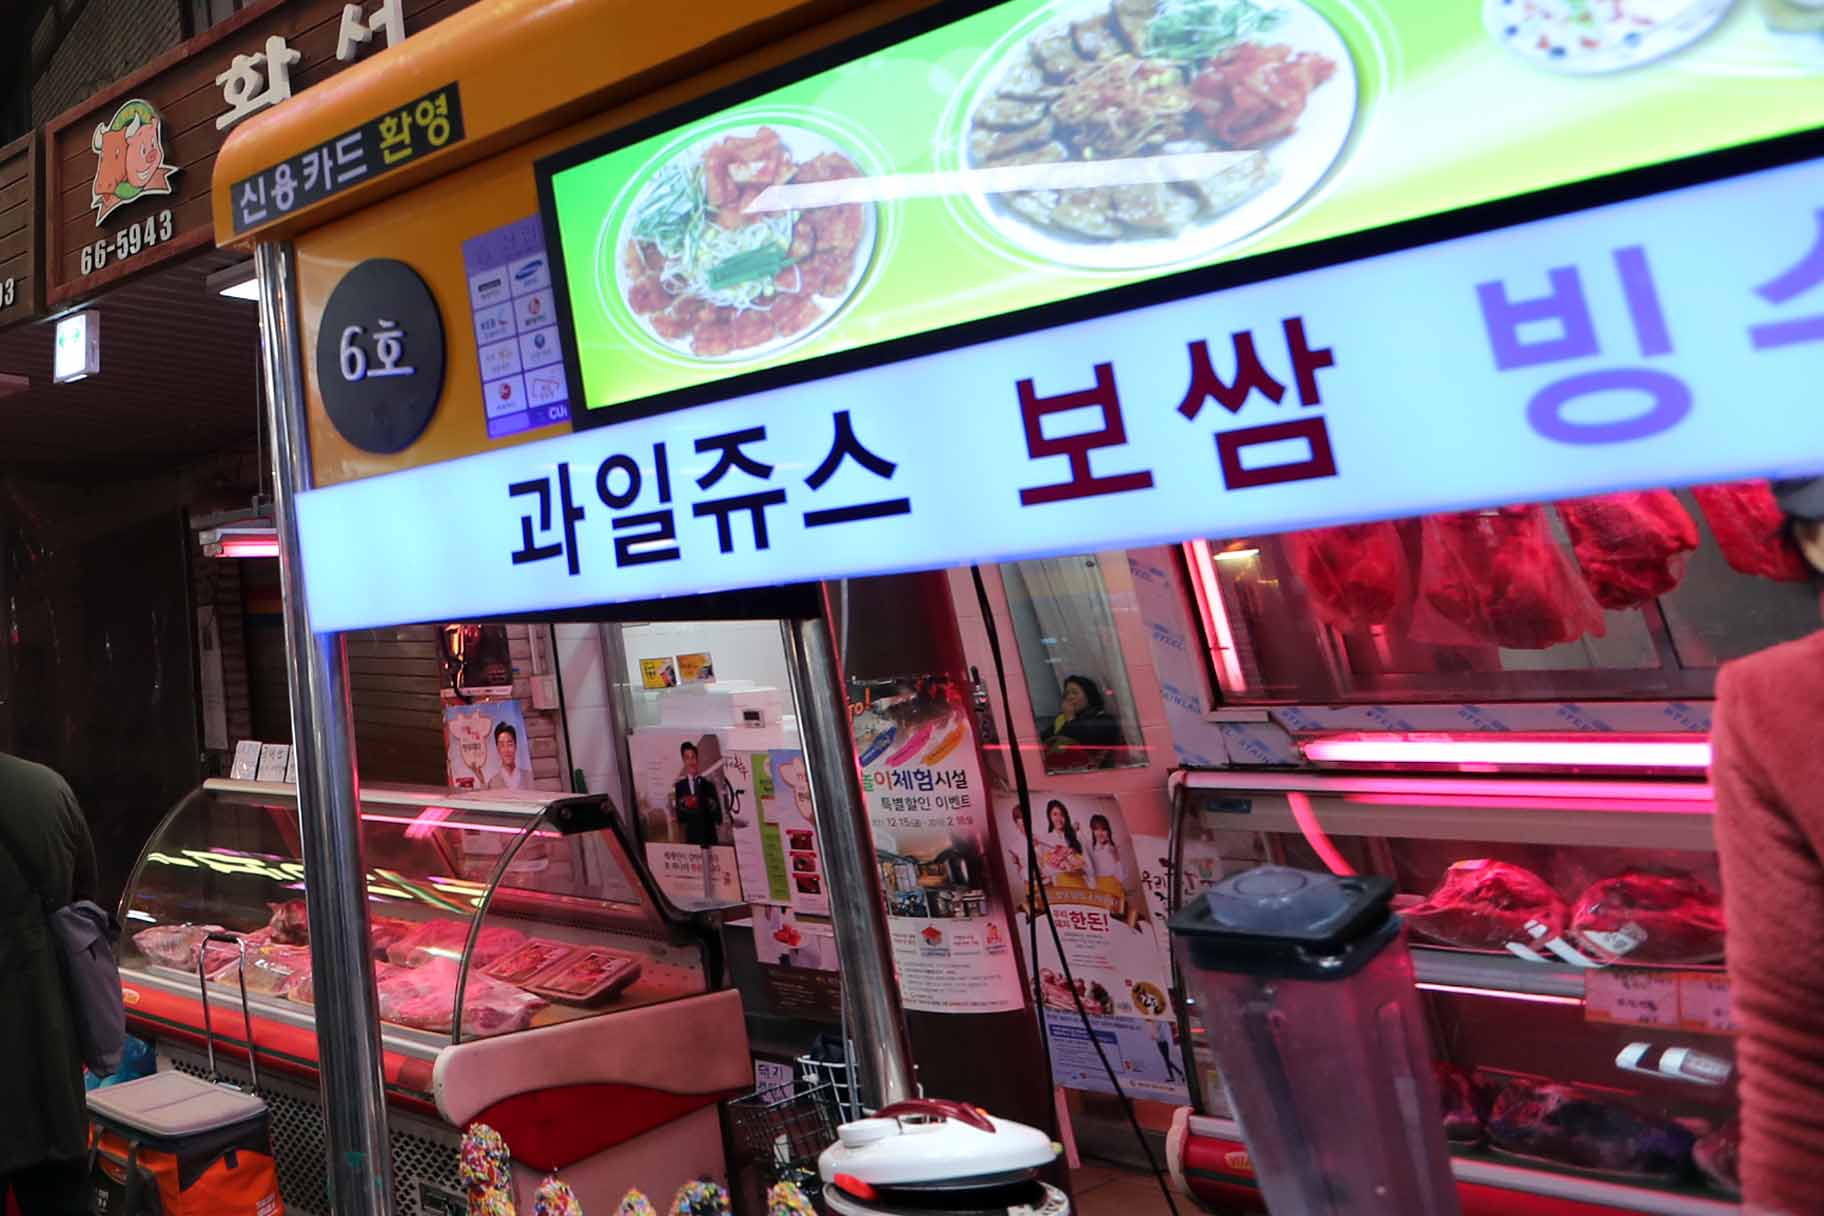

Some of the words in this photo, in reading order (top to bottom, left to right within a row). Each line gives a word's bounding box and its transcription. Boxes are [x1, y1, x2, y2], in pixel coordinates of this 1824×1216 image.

[239, 131, 369, 225] 신용카드
[378, 92, 451, 165] 환영
[80, 209, 173, 275] 66-5943
[339, 318, 416, 382] 6호
[507, 409, 913, 577] 과일쥬스
[1015, 315, 1341, 508] 보쌈
[935, 794, 972, 810] 이벤트
[1069, 910, 1111, 933] 한돈!
